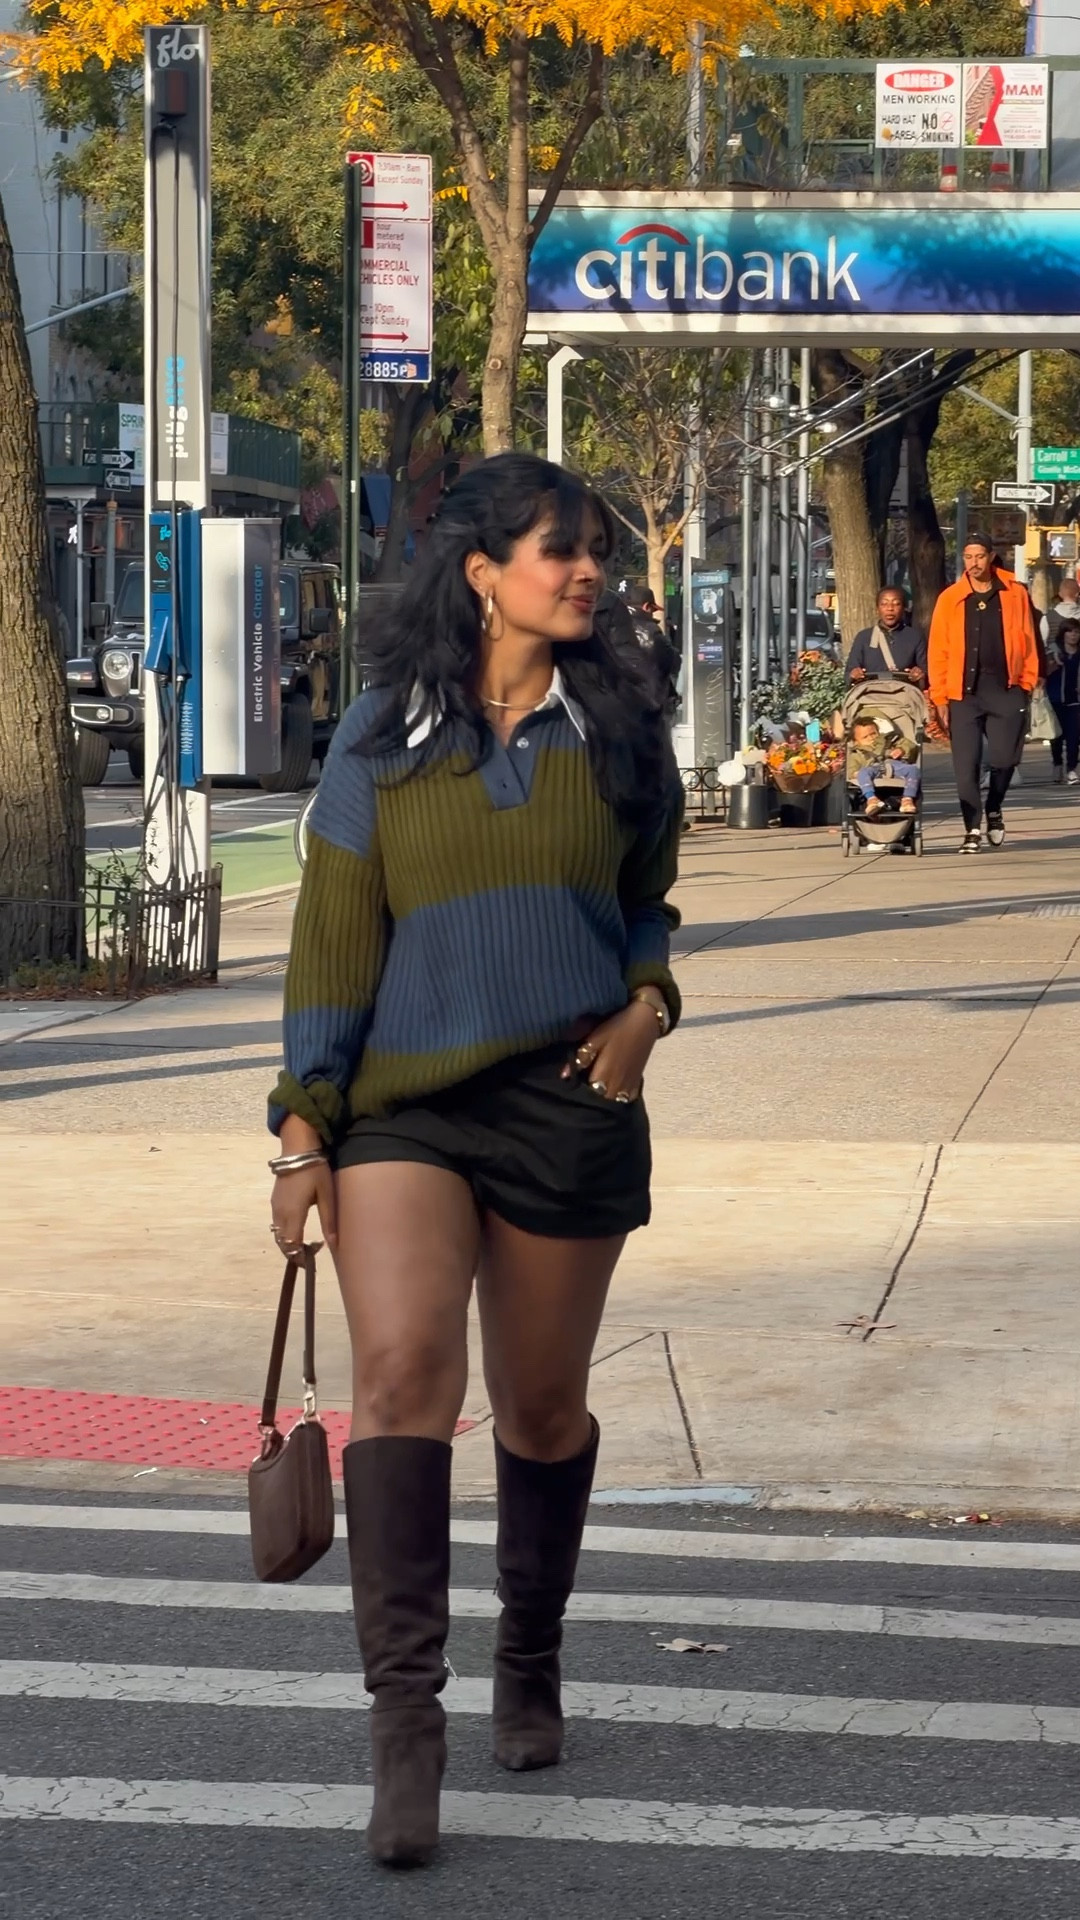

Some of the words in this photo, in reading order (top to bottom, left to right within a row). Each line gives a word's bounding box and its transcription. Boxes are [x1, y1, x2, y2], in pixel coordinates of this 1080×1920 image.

[156, 28, 200, 67] flo
[893, 73, 945, 88] DANGER
[1005, 84, 1043, 96] MAM
[883, 95, 904, 104] MEN
[907, 95, 956, 104] WORKING
[881, 114, 900, 124] HARD
[902, 114, 916, 124] HAT
[921, 113, 938, 130] NO
[894, 130, 917, 140] AREA
[921, 131, 954, 142] SMOKING
[377, 175, 399, 184] Except
[400, 176, 424, 185] Sunday
[376, 232, 404, 241] metered
[376, 242, 401, 252] parking
[360, 259, 410, 272] OMMERCIAL
[575, 234, 861, 301] citibank
[360, 273, 394, 285] EHICLES
[397, 275, 420, 286] ONLY
[374, 303, 394, 313] 10pm
[360, 316, 379, 326] cept
[381, 315, 410, 327] Sunday
[360, 362, 398, 377] 28885
[121, 413, 145, 428] SPRIN
[1037, 450, 1068, 461] Carroll
[1002, 489, 1019, 497] ONE
[253, 564, 264, 618] Charger
[252, 622, 264, 672] Vehicle
[252, 675, 263, 722] Electric
